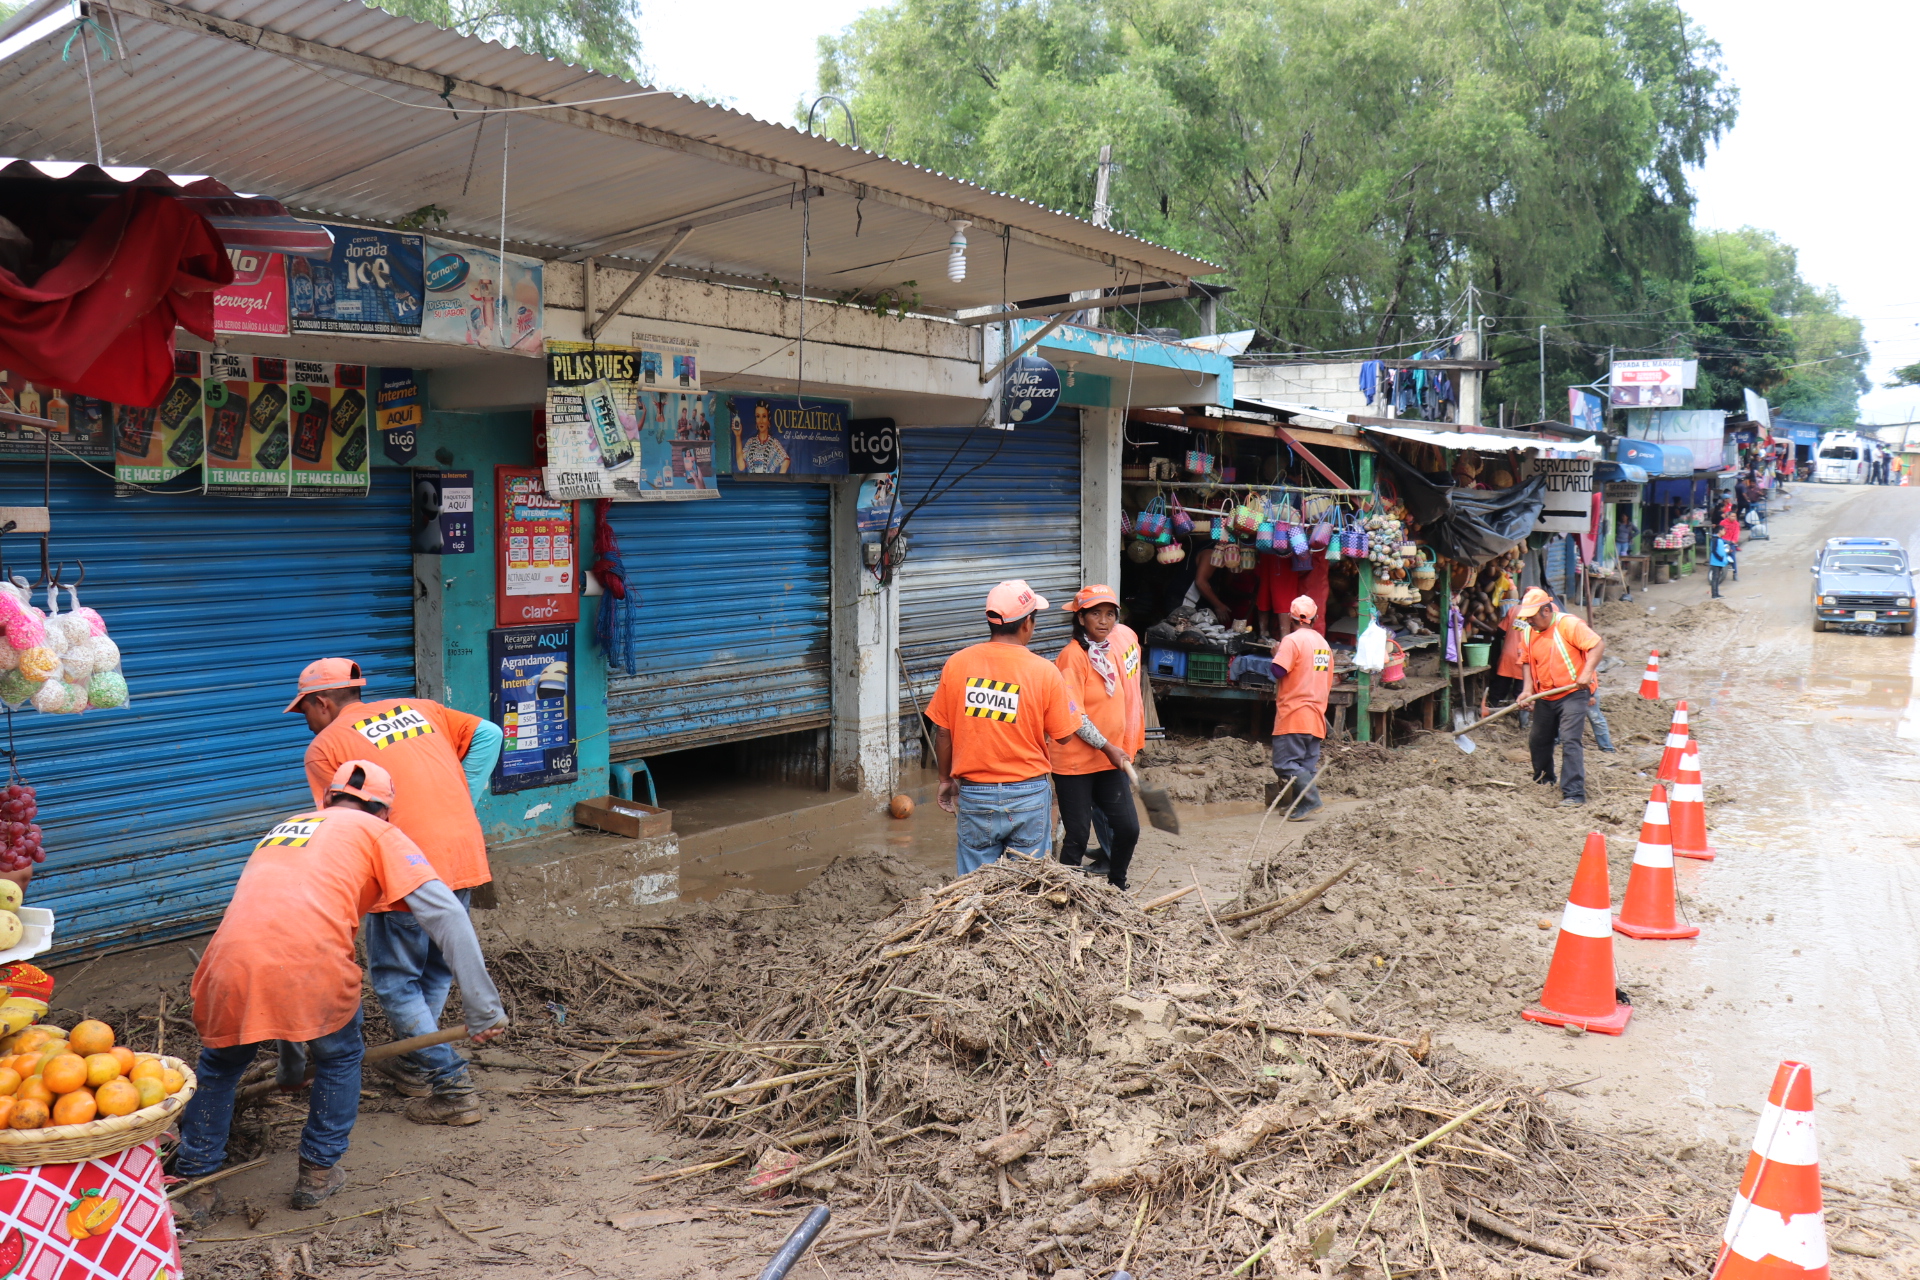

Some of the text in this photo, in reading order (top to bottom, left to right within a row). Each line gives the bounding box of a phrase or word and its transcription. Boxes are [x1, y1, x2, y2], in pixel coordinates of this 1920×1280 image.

[346, 243, 387, 257] dorada
[426, 257, 460, 286] Carnaval
[214, 292, 272, 314] cerveza!
[225, 320, 241, 329] SERIOS
[262, 322, 269, 331] LA
[299, 320, 320, 329] CONSUMO
[321, 321, 327, 329] DE
[328, 321, 338, 330] ESTE
[338, 322, 360, 331] PRODUCTO
[361, 323, 374, 331] CAUSA
[375, 324, 390, 332] SERIOS
[295, 361, 322, 373] MENOS
[553, 355, 634, 380] PILAS PUES
[295, 372, 330, 384] ESPUMA
[1006, 372, 1043, 385] Alka-
[378, 385, 417, 403] Internet
[1009, 385, 1059, 398] Seltzer
[386, 406, 413, 425] AQUÍ
[593, 396, 618, 445] SPEED
[774, 408, 842, 434] QUEZALTECA
[1533, 459, 1591, 473] SERVICIO
[119, 468, 131, 481] TE
[134, 468, 161, 481] HACE
[212, 471, 286, 483] TE HACE GANAS
[296, 472, 365, 485] TE HACE GANAS
[557, 472, 566, 485] YA
[448, 500, 467, 510] AQUÍ
[513, 495, 527, 504] DEL
[522, 603, 555, 619] Claro
[504, 630, 569, 649] Recárgate AQUÍ
[501, 655, 555, 670] Agrandamos
[515, 669, 523, 677] tu
[501, 678, 535, 689] Internet
[967, 691, 1016, 710] COVIAL
[366, 713, 424, 738] COVIAL
[269, 824, 311, 836] VIAL
